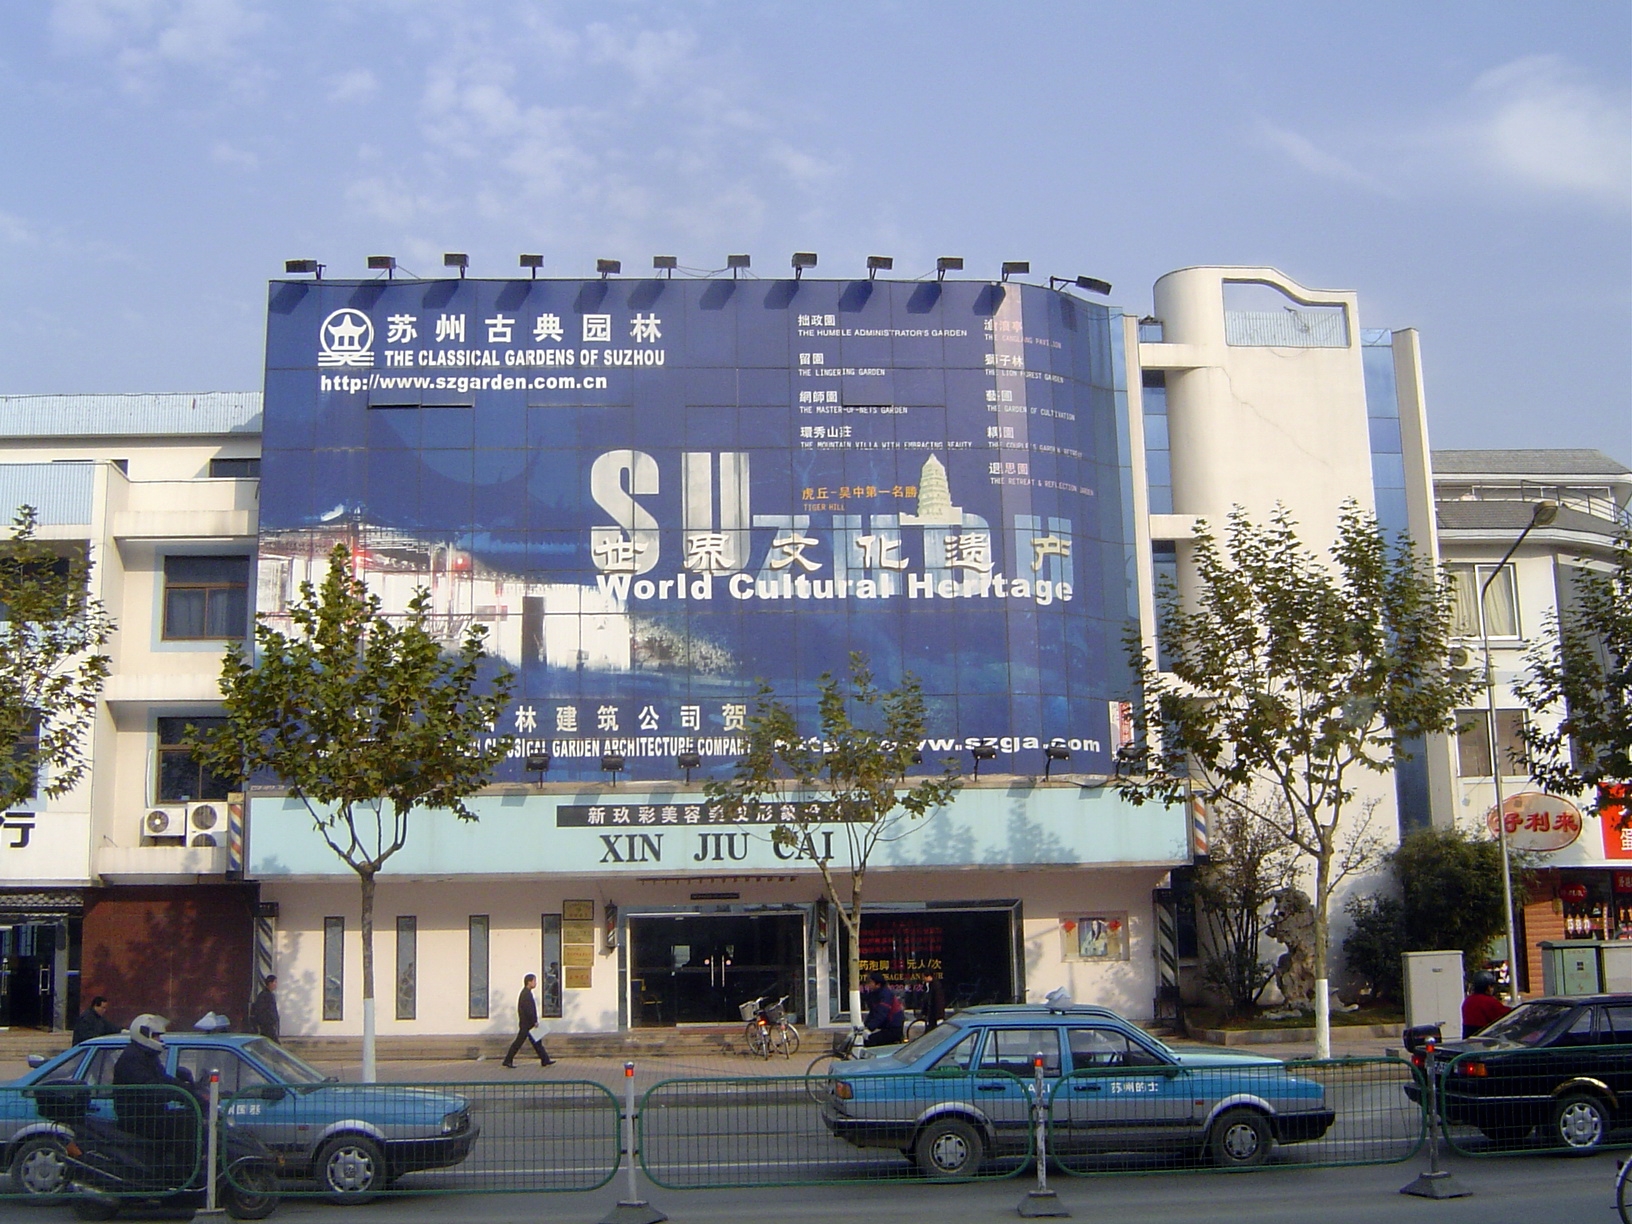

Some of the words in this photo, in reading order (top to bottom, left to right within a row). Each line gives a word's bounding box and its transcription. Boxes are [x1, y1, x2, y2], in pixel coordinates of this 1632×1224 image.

[386, 313, 662, 343] 苏州古典园林
[798, 329, 815, 337] THE
[817, 329, 851, 337] HUMBLE
[854, 329, 929, 337] ADMINISTRATOR'S
[931, 329, 967, 337] GARDEN
[985, 333, 1000, 341] THE
[385, 350, 413, 366] THE
[418, 350, 500, 366] CLASSICAL
[504, 350, 577, 366] GARDENS
[580, 350, 598, 366] OF
[603, 349, 665, 366] SUZHOU
[816, 368, 855, 376] LINGERING
[859, 368, 885, 376] GARDEN
[1002, 369, 1018, 377] LION
[1020, 370, 1042, 380] FOREST
[1044, 374, 1064, 384] GARDEN
[320, 373, 607, 393] http://www.szgarden.com.cn
[800, 405, 812, 413] THE
[881, 405, 908, 414] GARDEN
[987, 404, 1000, 412] THE
[1004, 405, 1027, 413] GARDEN
[1040, 408, 1075, 421] CULTIVATION
[801, 441, 813, 450] THE
[817, 441, 851, 450] MOUNTAIN
[855, 441, 878, 450] VILLA
[881, 441, 900, 450] WITH
[904, 441, 943, 450] EMBRACING
[988, 441, 1002, 450] THE
[990, 477, 1004, 485] THE
[1008, 477, 1035, 486] RETREAT
[1045, 480, 1077, 492] REFLECTION
[596, 572, 712, 600] World
[729, 572, 895, 600] Cultural
[908, 572, 1073, 606] Heritage
[485, 738, 548, 757] CLSSICAL
[552, 737, 599, 757] GARDEN
[604, 737, 693, 757] ARCHITECTURE
[600, 832, 664, 863] XIN
[693, 832, 750, 862] JIU
[773, 831, 834, 860] CAI
